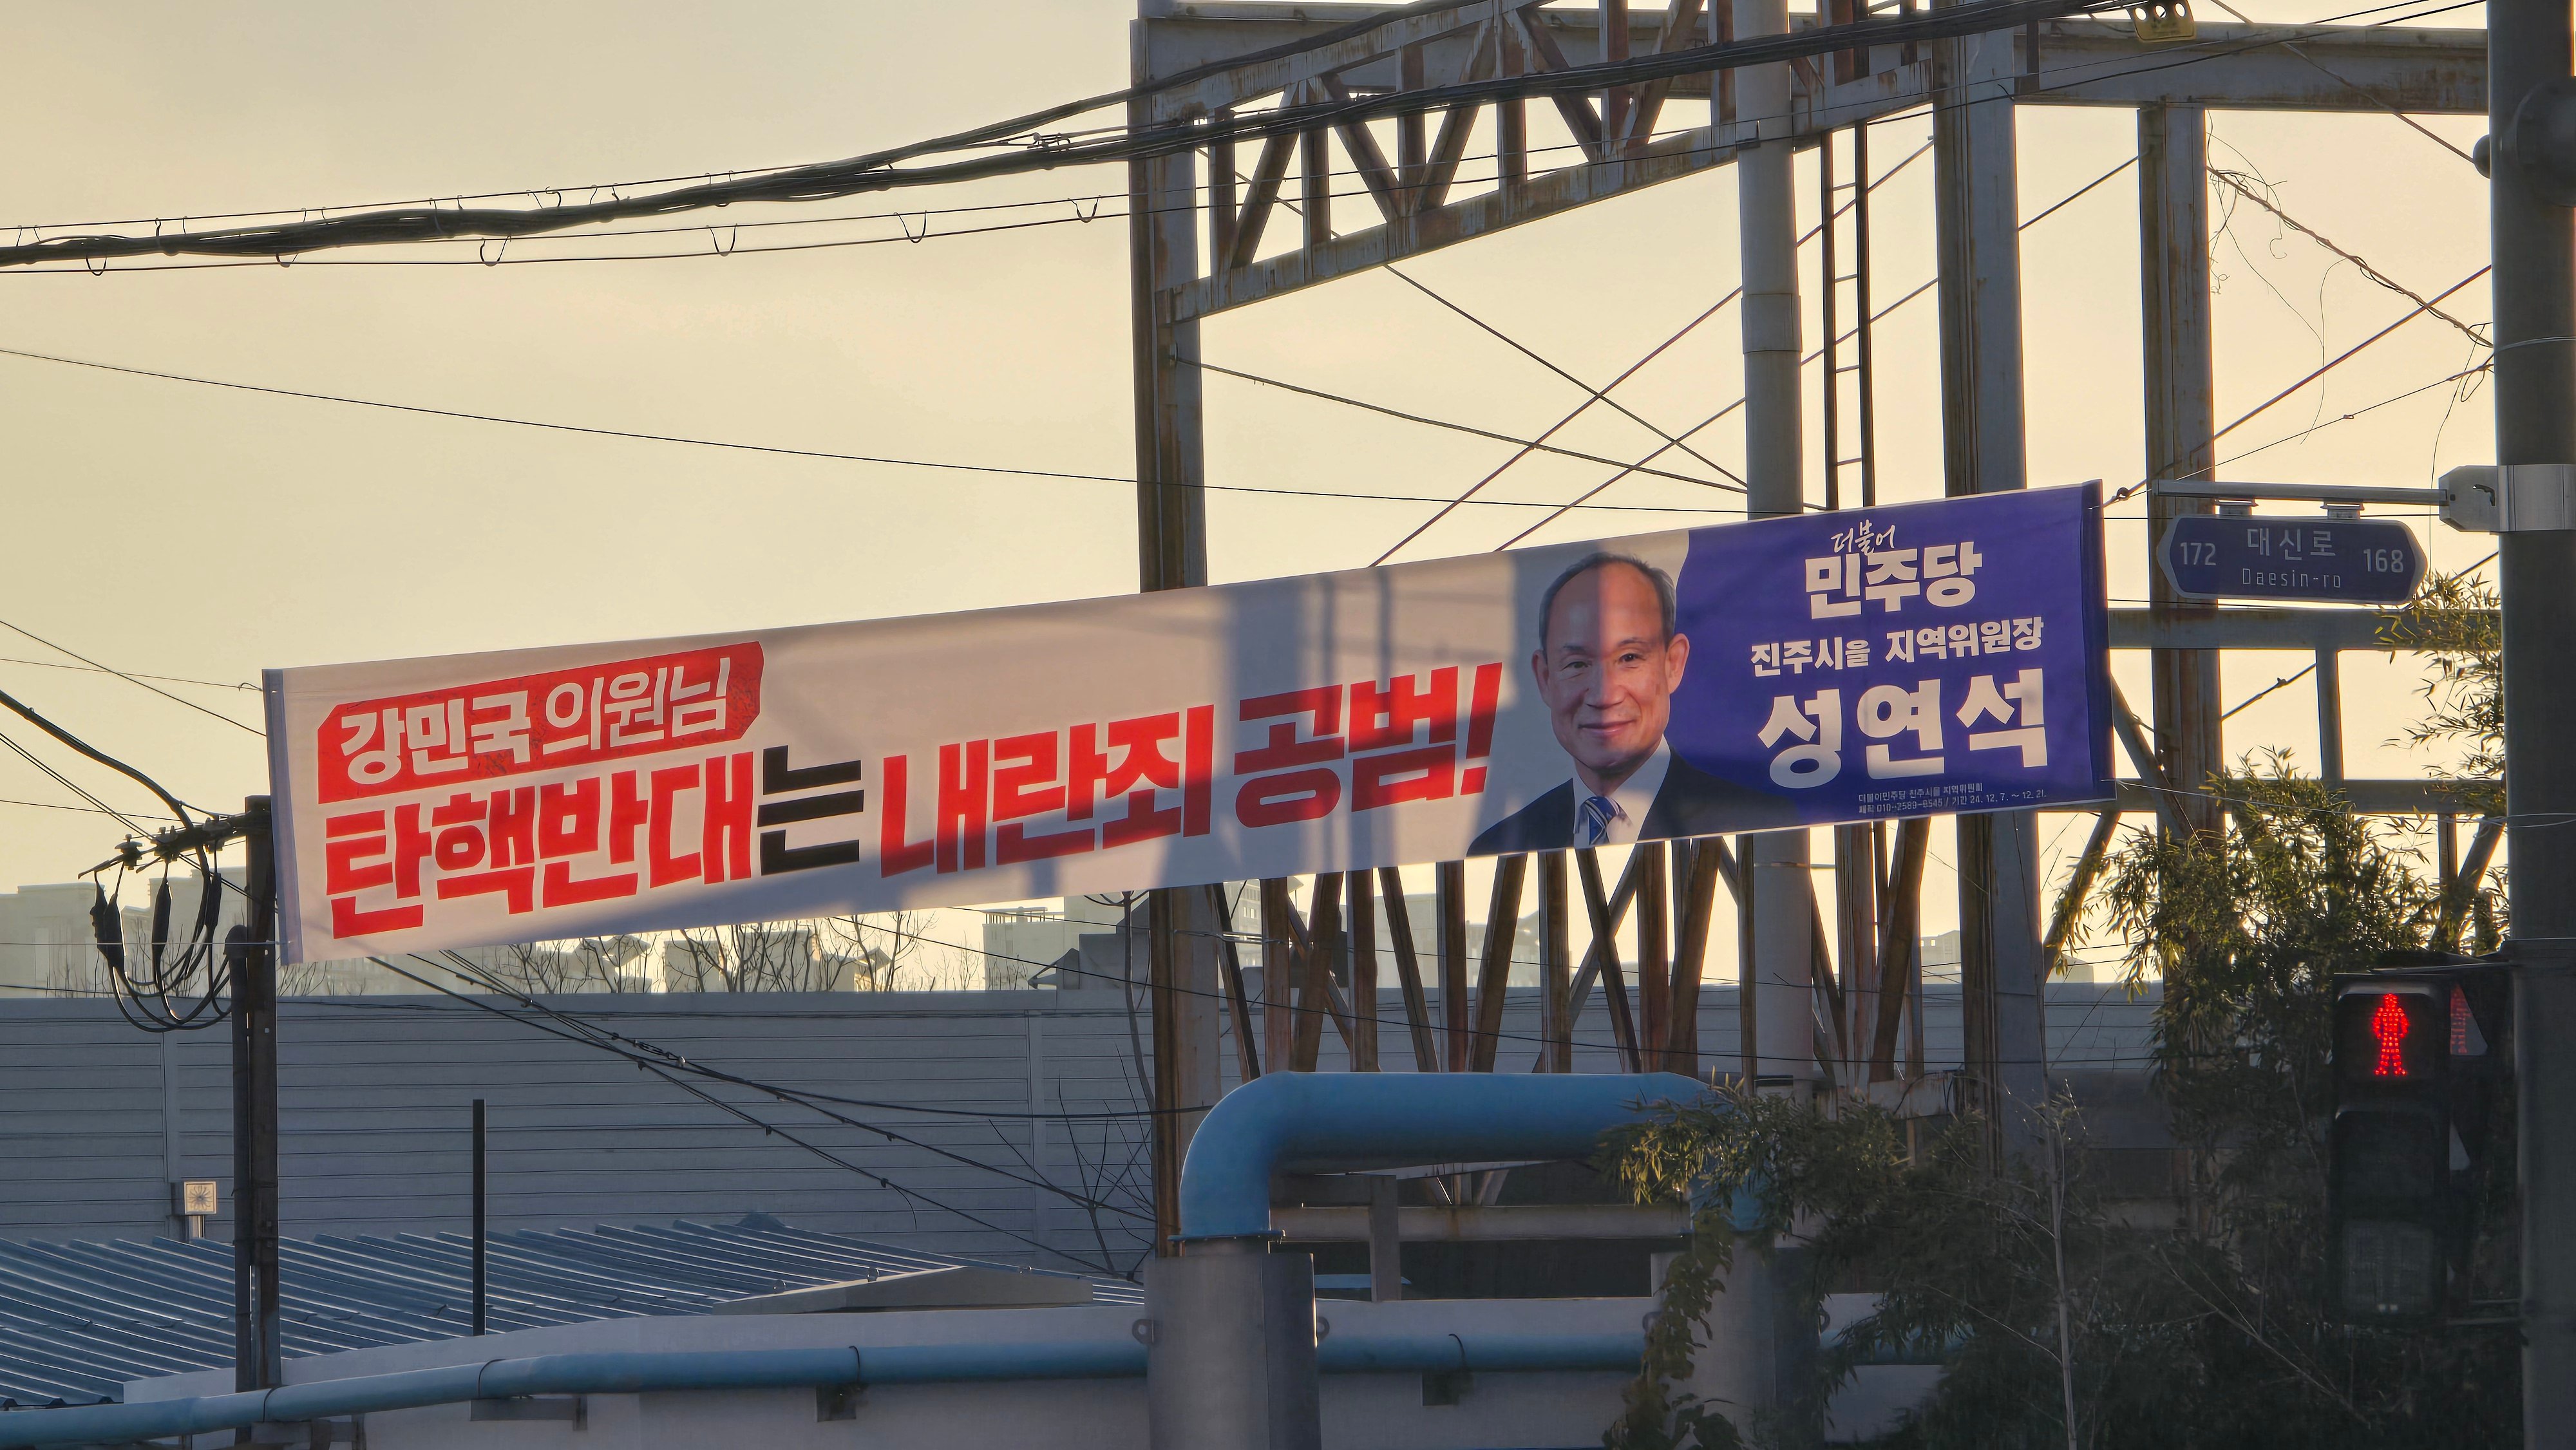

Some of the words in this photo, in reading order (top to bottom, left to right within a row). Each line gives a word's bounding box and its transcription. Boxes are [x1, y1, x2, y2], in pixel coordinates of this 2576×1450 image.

[1831, 520, 1896, 554] 더불어
[2179, 542, 2217, 566] 172
[2247, 528, 2336, 561] 대신로
[2363, 549, 2403, 573] 168
[1805, 541, 1982, 619] 민주당
[2242, 568, 2342, 589] Daesin-ro
[1751, 636, 1870, 677] 진주시을
[1886, 616, 2044, 663] 지역위원장
[1757, 668, 2048, 789] 성연석
[325, 744, 864, 939] 탄핵반대는
[880, 704, 1215, 878] 내란죄
[1233, 662, 1502, 829] 공범!
